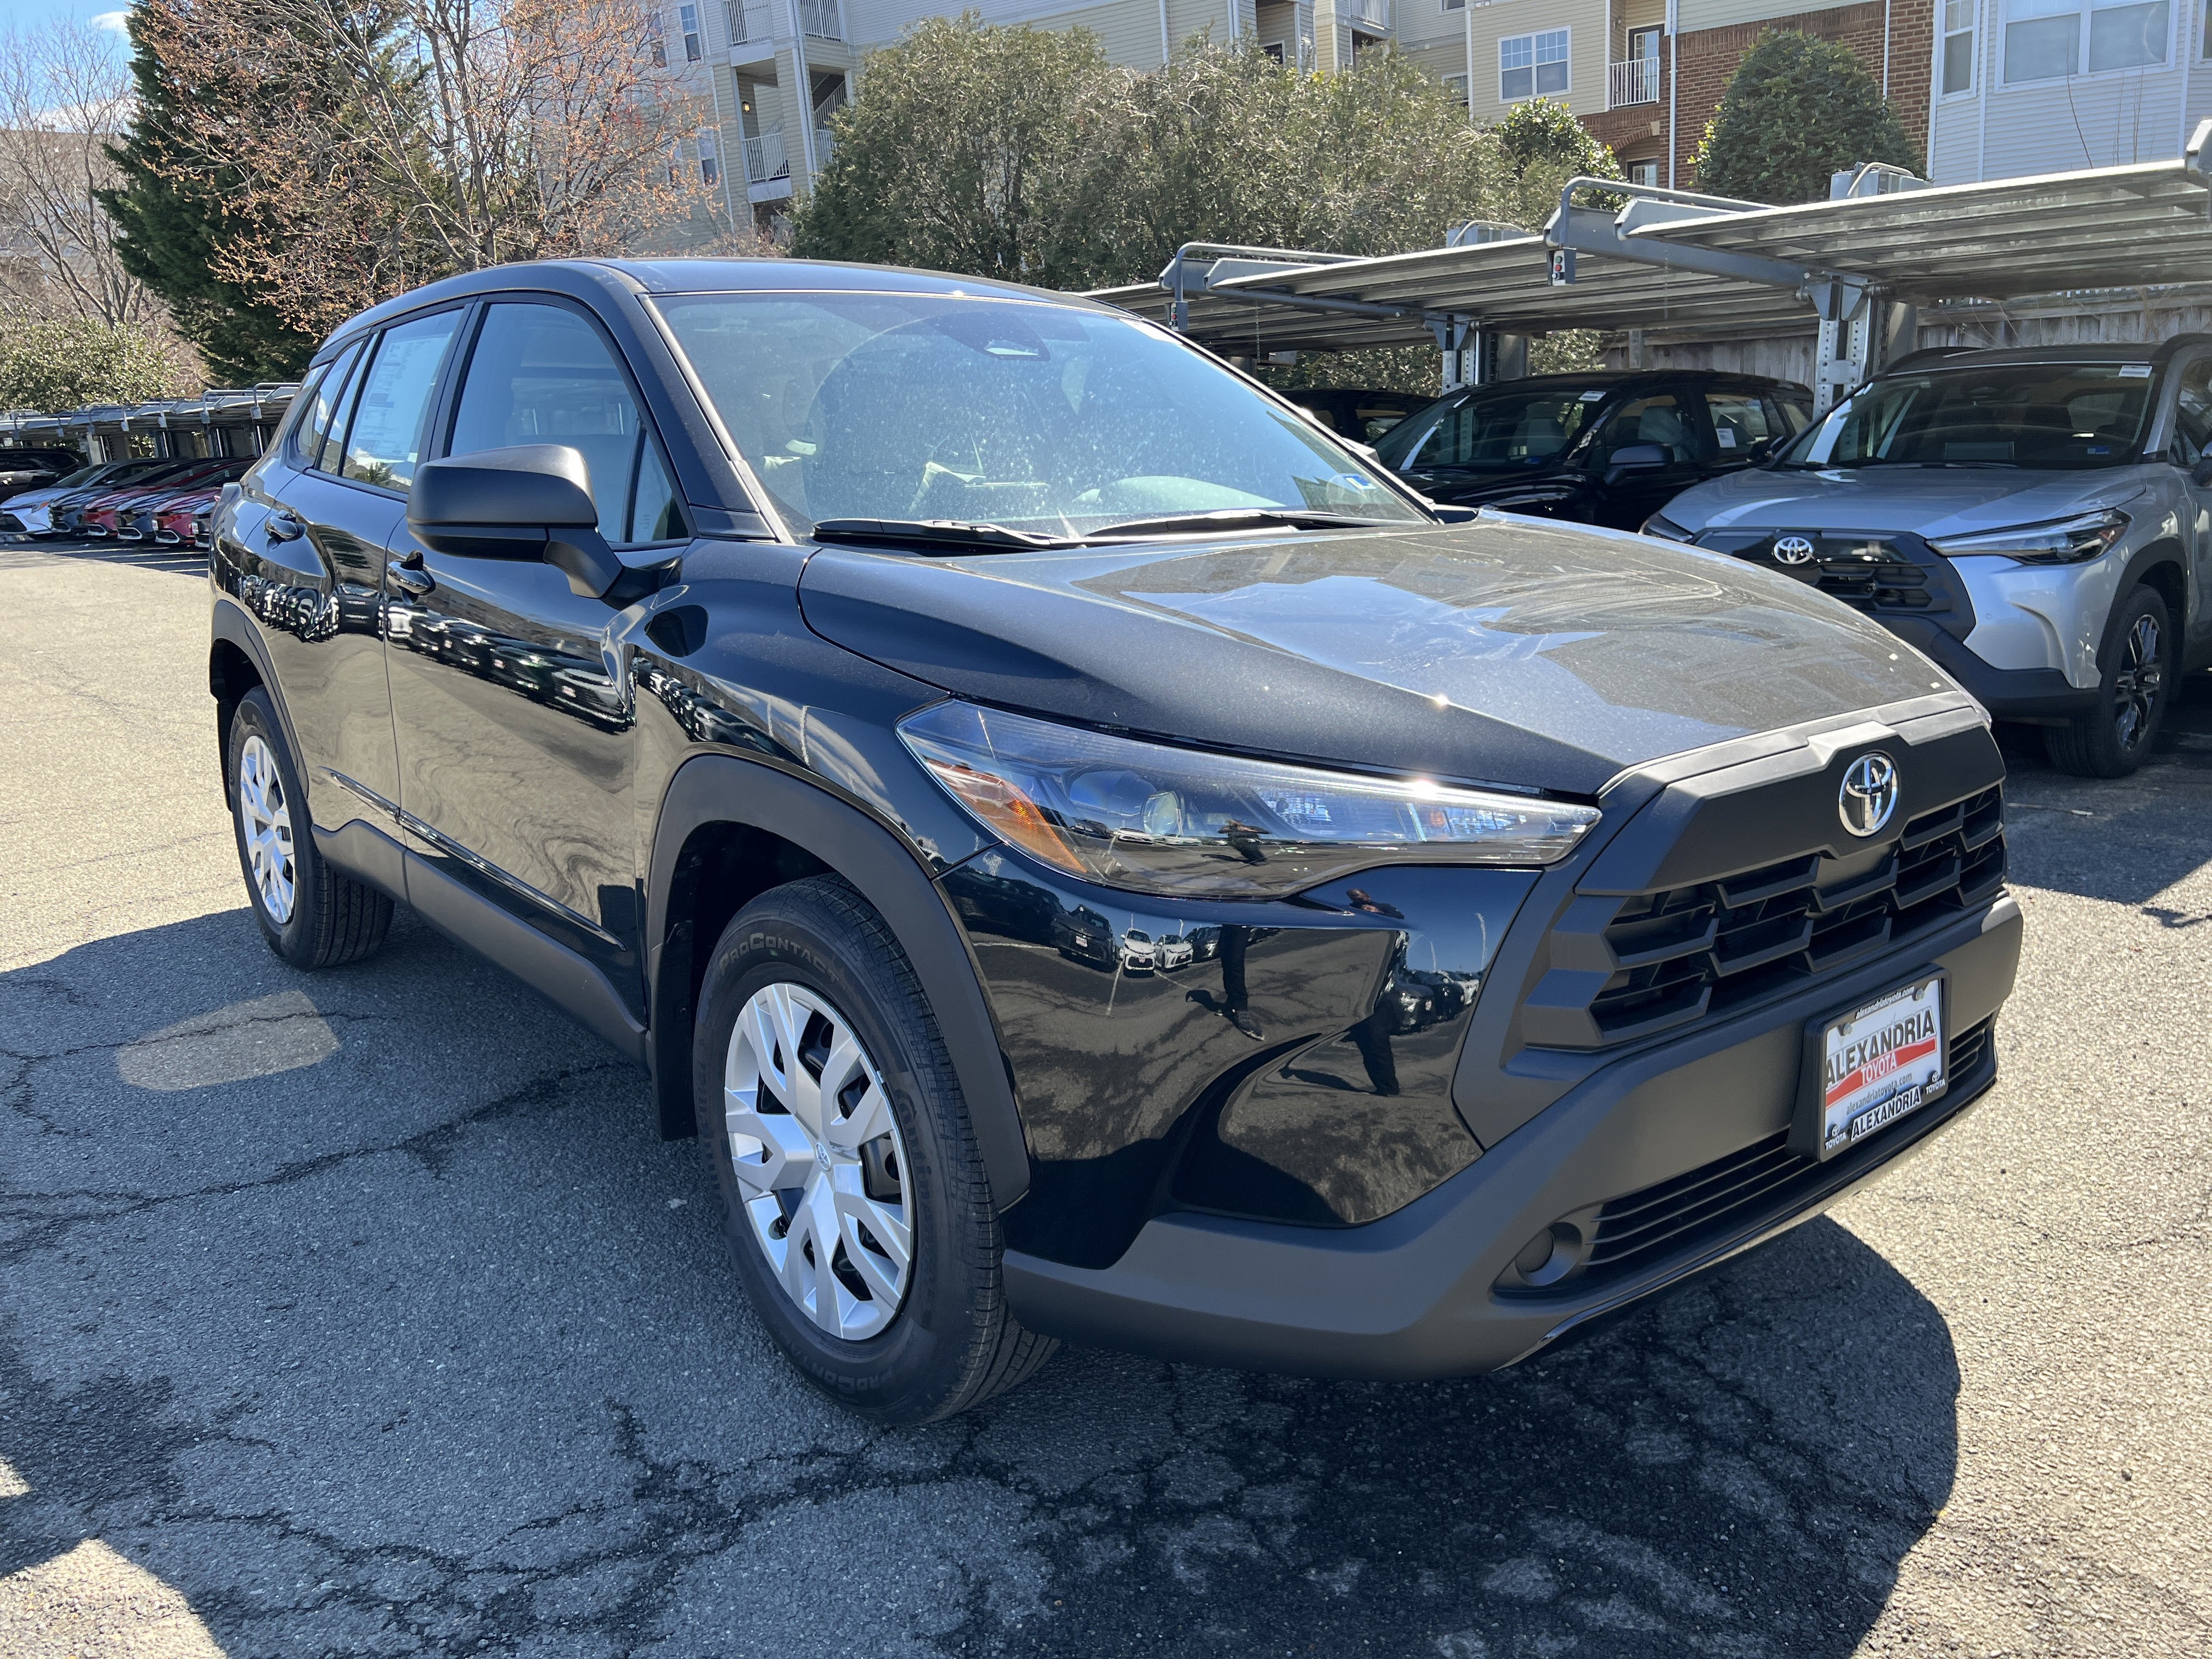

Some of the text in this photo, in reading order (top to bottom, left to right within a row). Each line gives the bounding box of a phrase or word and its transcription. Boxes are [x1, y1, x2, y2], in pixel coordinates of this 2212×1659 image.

[1826, 1008, 1935, 1087] ALEXANDRIA
[1860, 1052, 1897, 1086] TOYOTA
[1926, 1078, 1946, 1095] TOYOTA
[1846, 1073, 1912, 1115] alexandriatoyota.com
[1852, 1086, 1921, 1141] ALEXANDRIA
[1825, 1131, 1847, 1150] TOYOTA
